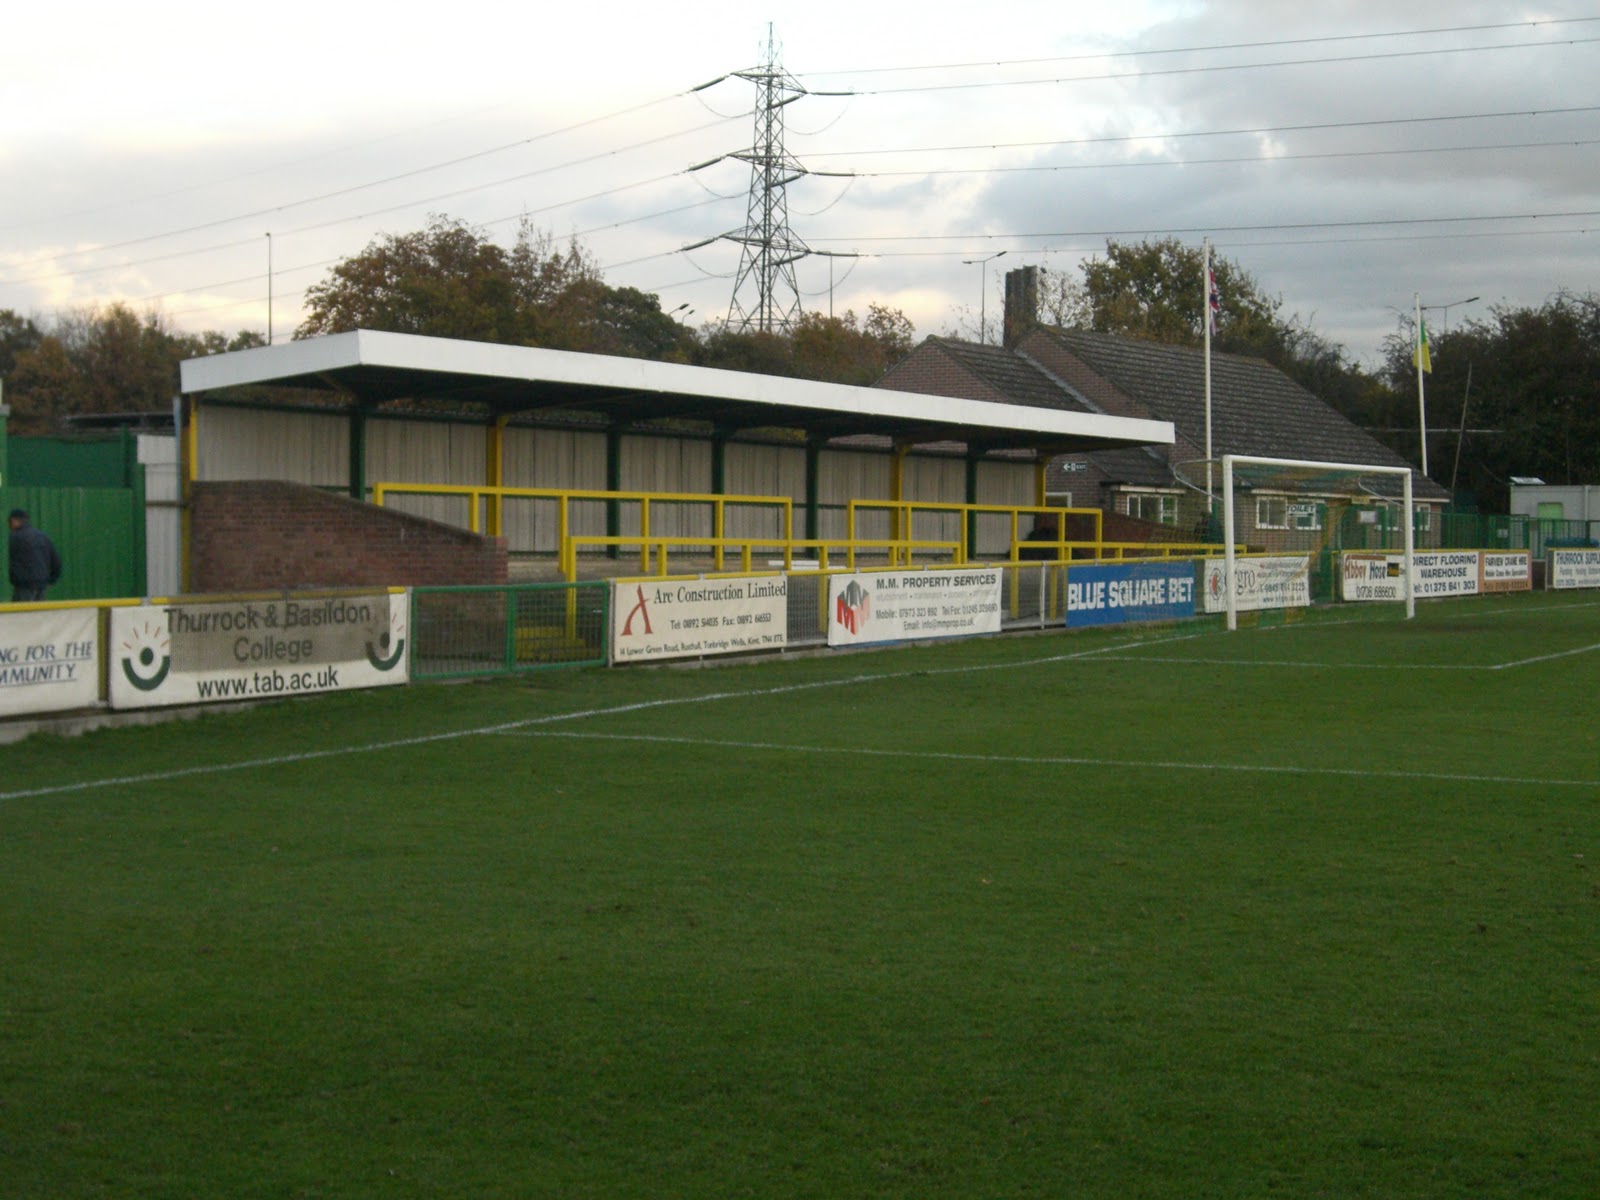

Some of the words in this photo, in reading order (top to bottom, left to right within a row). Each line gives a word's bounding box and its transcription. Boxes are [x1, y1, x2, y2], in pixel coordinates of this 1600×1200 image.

[1441, 554, 1477, 565] FLOORING
[1420, 567, 1467, 578] WAREHOUSE
[876, 578, 899, 590] M.M.
[902, 576, 952, 588] PROPERTY
[953, 574, 997, 586] SERVICES
[1424, 582, 1446, 593] 01375
[653, 588, 673, 604] Arc
[677, 584, 744, 602] Construction
[747, 581, 787, 598] Limited
[1068, 582, 1105, 611] BLUE
[1108, 578, 1166, 607] SQUARE
[1169, 577, 1194, 603] BET
[164, 606, 261, 633] Thurrock
[263, 603, 277, 627] &
[285, 600, 371, 627] Basildon
[722, 616, 735, 626] Fax:
[25, 643, 56, 661] FOR
[64, 640, 94, 658] THE
[233, 636, 313, 664] College
[645, 644, 662, 654] Green
[197, 666, 339, 698] www.tab.ac.uk
